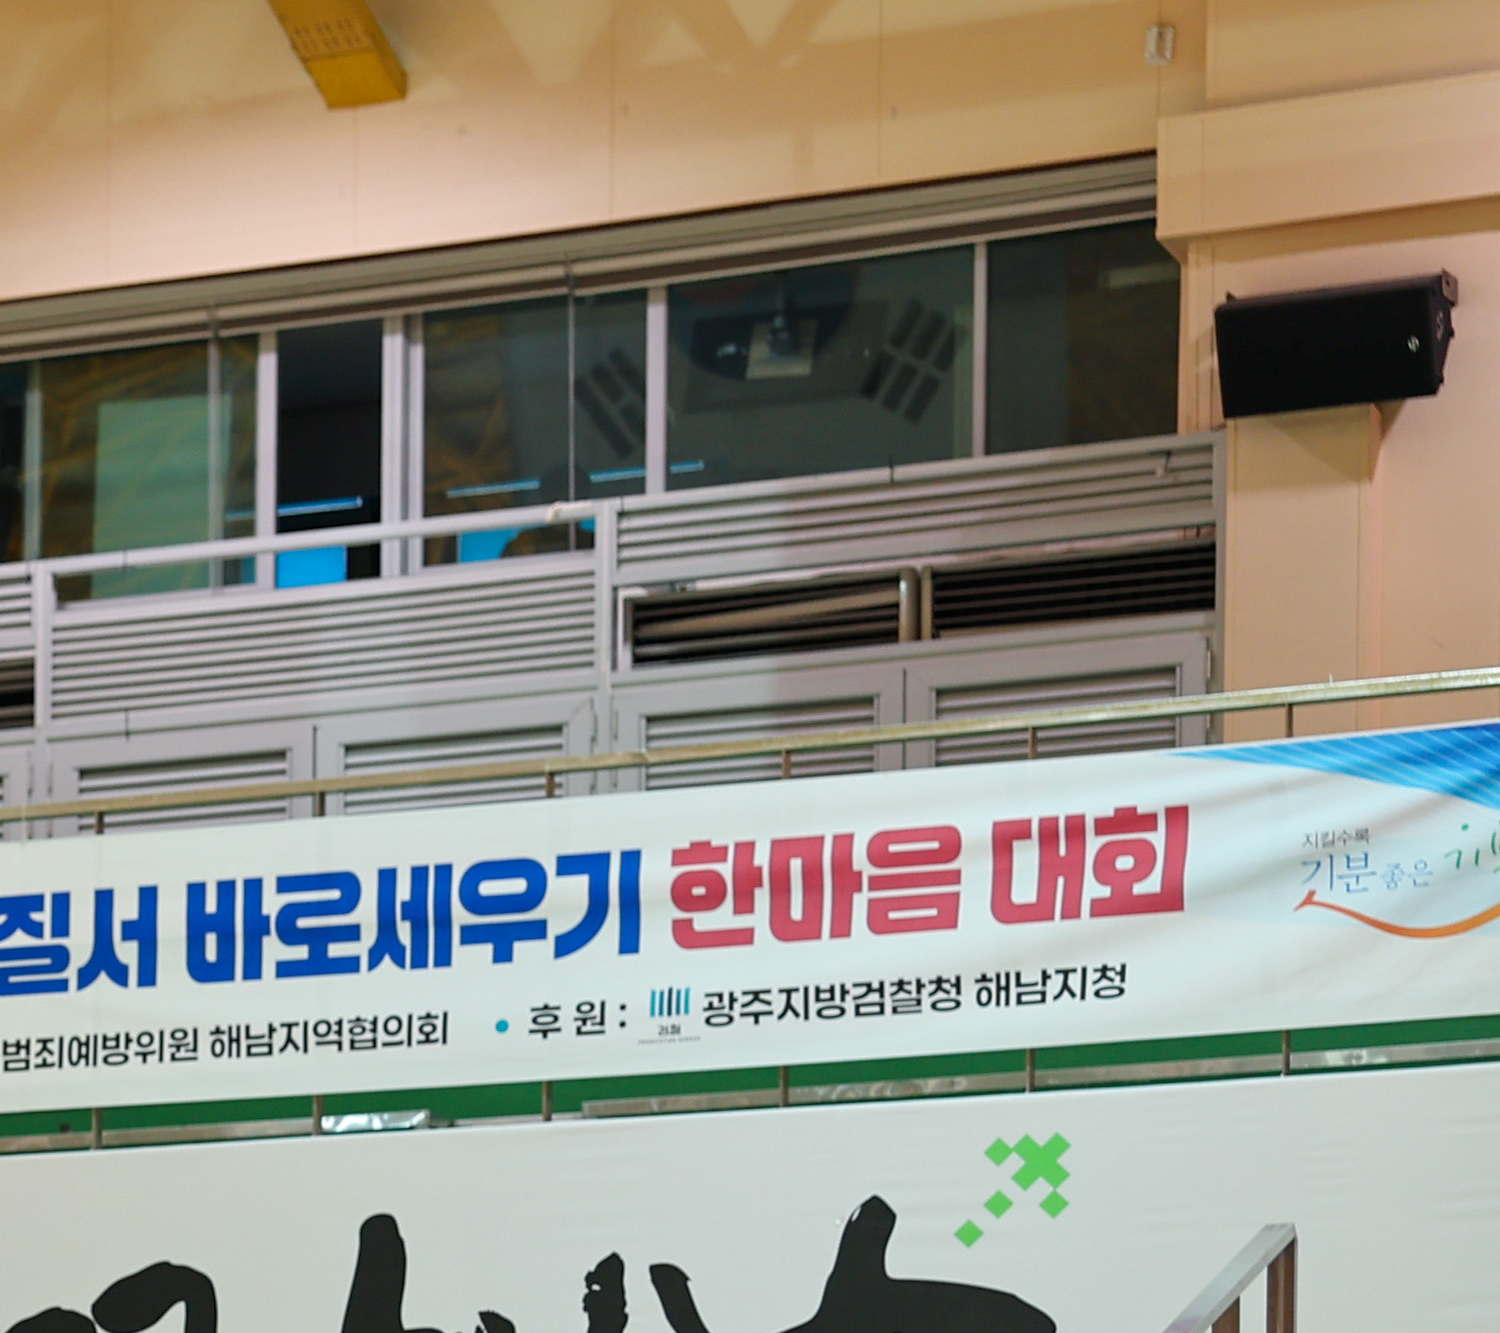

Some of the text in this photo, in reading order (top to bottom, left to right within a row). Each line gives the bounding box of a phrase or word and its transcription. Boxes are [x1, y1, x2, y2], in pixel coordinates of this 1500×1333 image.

[1302, 828, 1370, 848] 지킬수록
[186, 849, 642, 985] 바로세우기
[670, 824, 962, 950] 한마음
[991, 803, 1190, 925] 대회
[1301, 852, 1377, 893] 기분
[702, 974, 963, 1028] 광주지방검찰청
[973, 962, 1128, 1010] 해남지청
[2, 1025, 199, 1073] 범죄예방위원
[209, 1009, 449, 1061] 해남지역협의회
